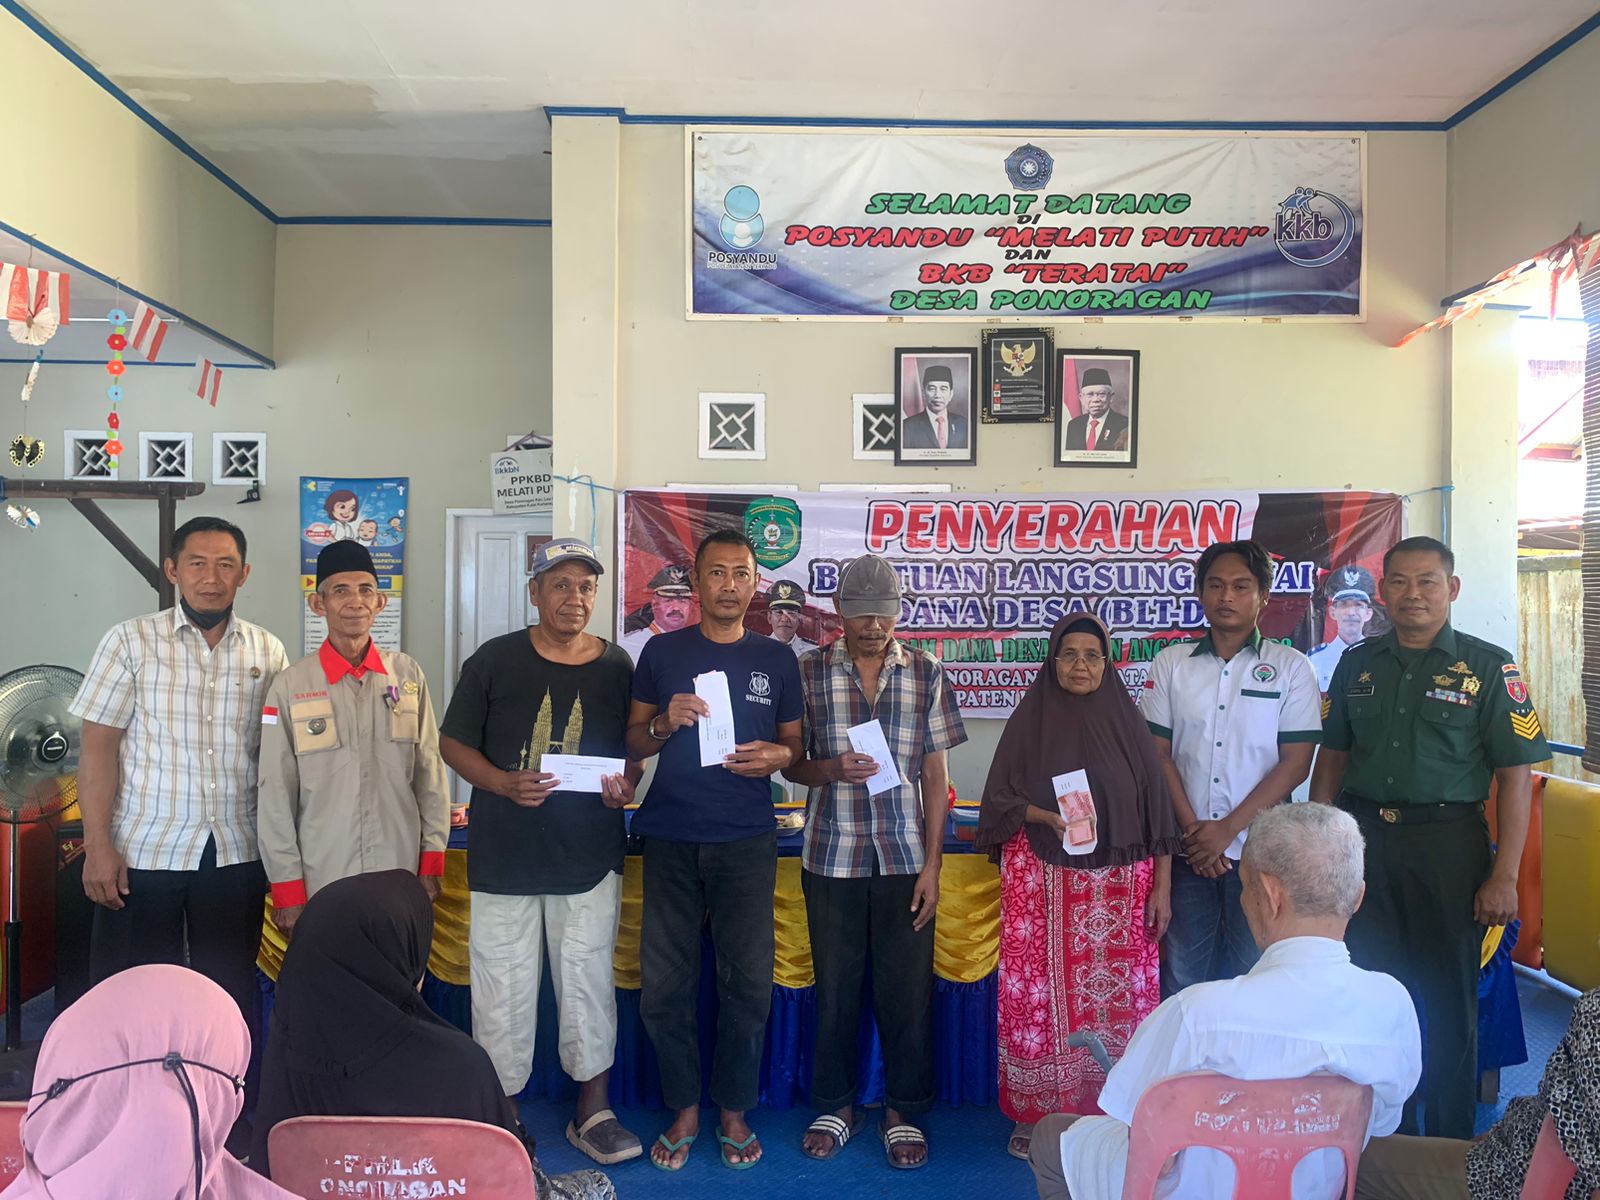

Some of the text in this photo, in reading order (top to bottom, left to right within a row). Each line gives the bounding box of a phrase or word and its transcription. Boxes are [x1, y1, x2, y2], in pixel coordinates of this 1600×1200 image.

[865, 192, 1191, 215] SELAMAT DATANG
[1016, 213, 1041, 225] DI
[1274, 210, 1335, 242] kkb
[784, 224, 974, 248] POSYANDU
[708, 251, 777, 264] POSYANDU
[1004, 248, 1052, 261] DAN
[918, 262, 993, 284] BKB
[889, 289, 1213, 311] DESA PONORAGAN
[510, 473, 552, 485] PPKBD
[497, 486, 534, 498] MELATI
[867, 501, 1239, 552] PENYERAHAN
[996, 563, 1193, 592] LANGSUNG
[897, 599, 986, 625] DANA
[943, 638, 995, 662] DANA
